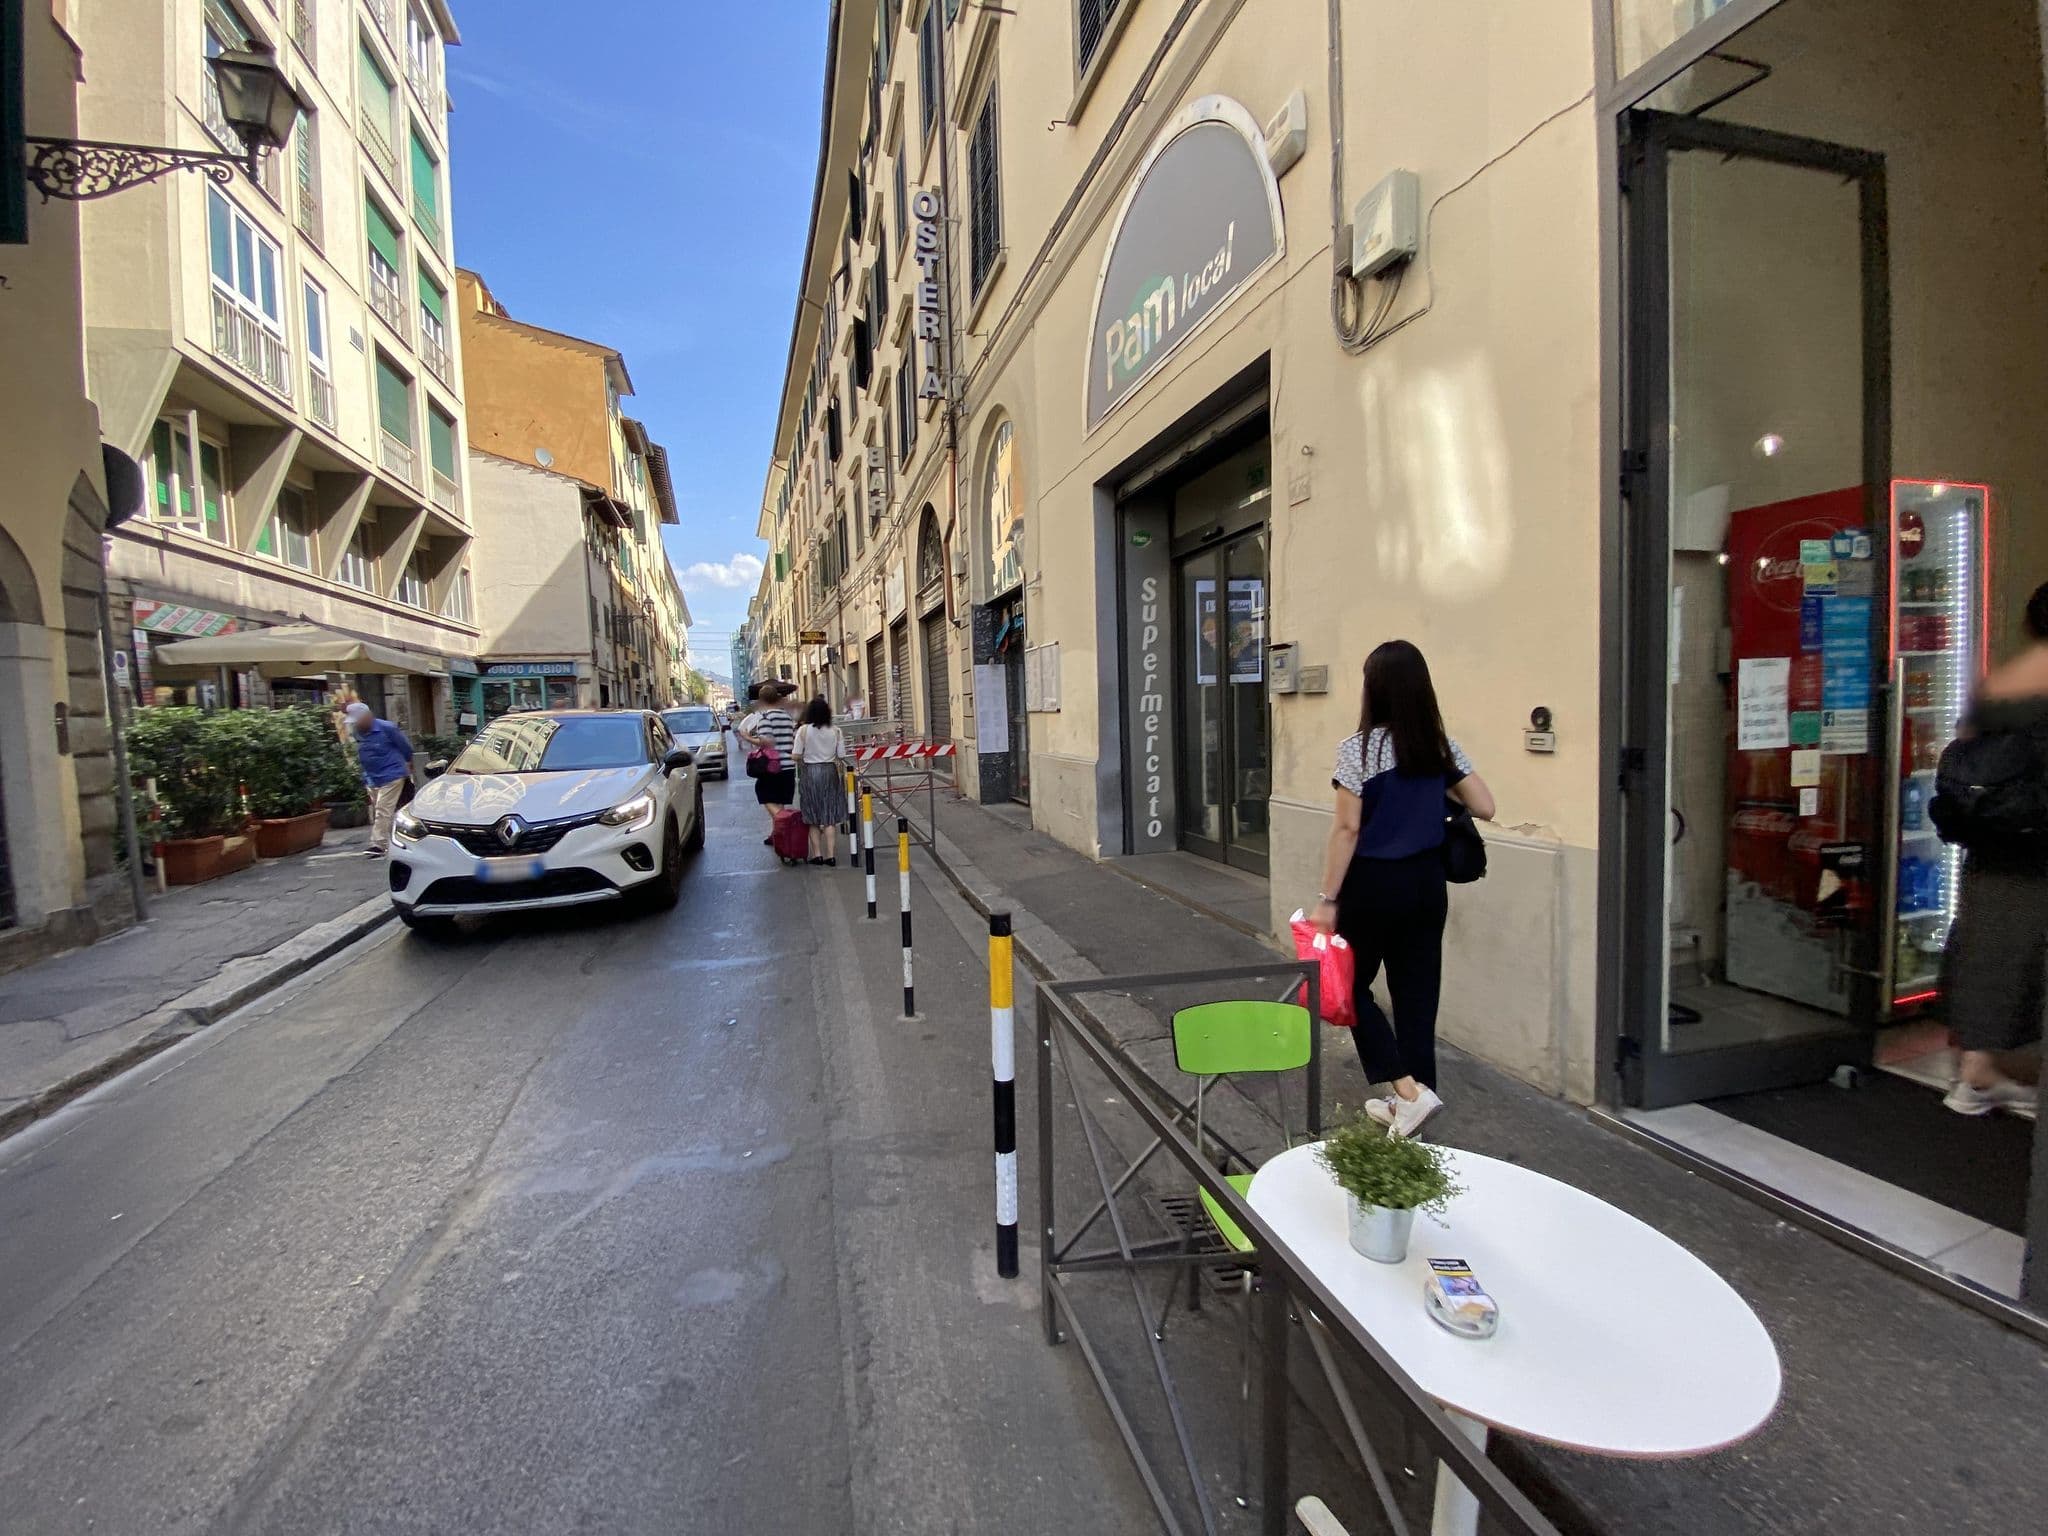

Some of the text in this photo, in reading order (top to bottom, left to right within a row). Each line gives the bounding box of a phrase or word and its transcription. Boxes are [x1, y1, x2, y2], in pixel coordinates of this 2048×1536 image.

[912, 191, 945, 399] OSTERIA
[1181, 220, 1235, 318] local
[528, 664, 570, 674] ALBION
[1140, 576, 1163, 838] Supermercato
